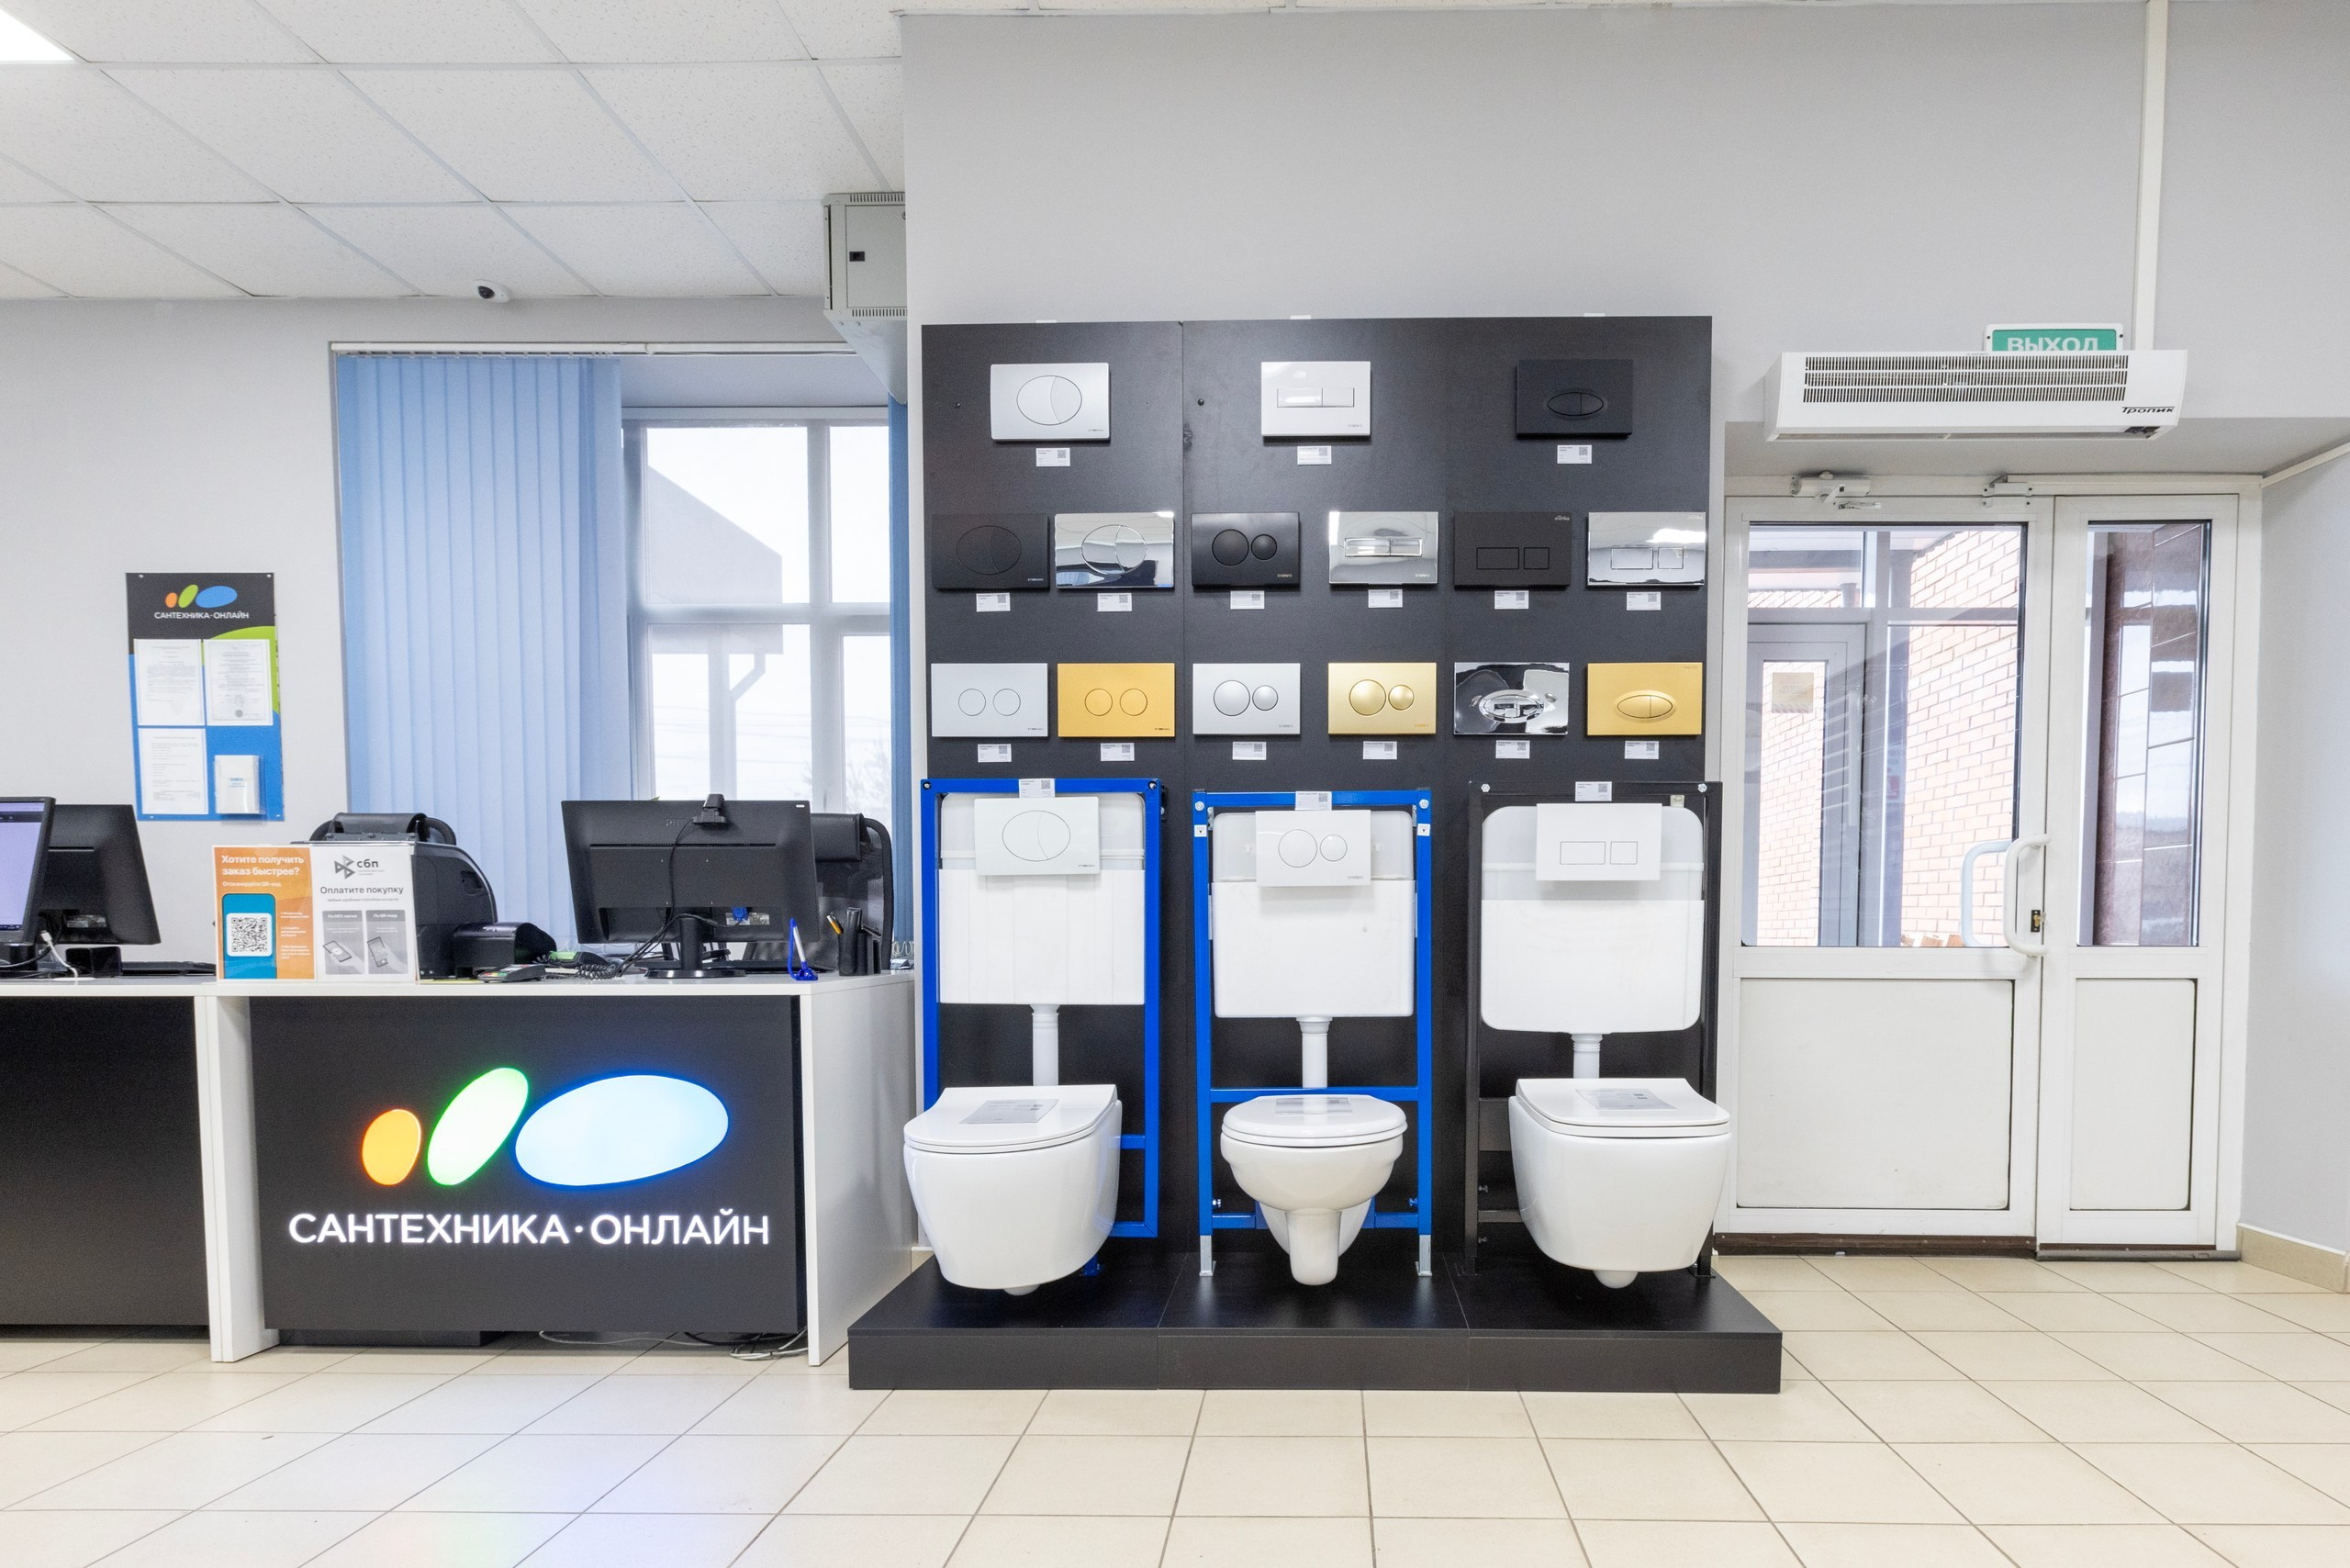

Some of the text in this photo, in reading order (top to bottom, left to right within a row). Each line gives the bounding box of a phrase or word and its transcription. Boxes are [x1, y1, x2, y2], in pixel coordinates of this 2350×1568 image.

[2122, 406, 2175, 414] Тропик
[221, 855, 305, 865] Хотите получить
[356, 858, 379, 868] сбп
[252, 867, 300, 876] быстрее?
[319, 886, 404, 895] Оплатите покупку
